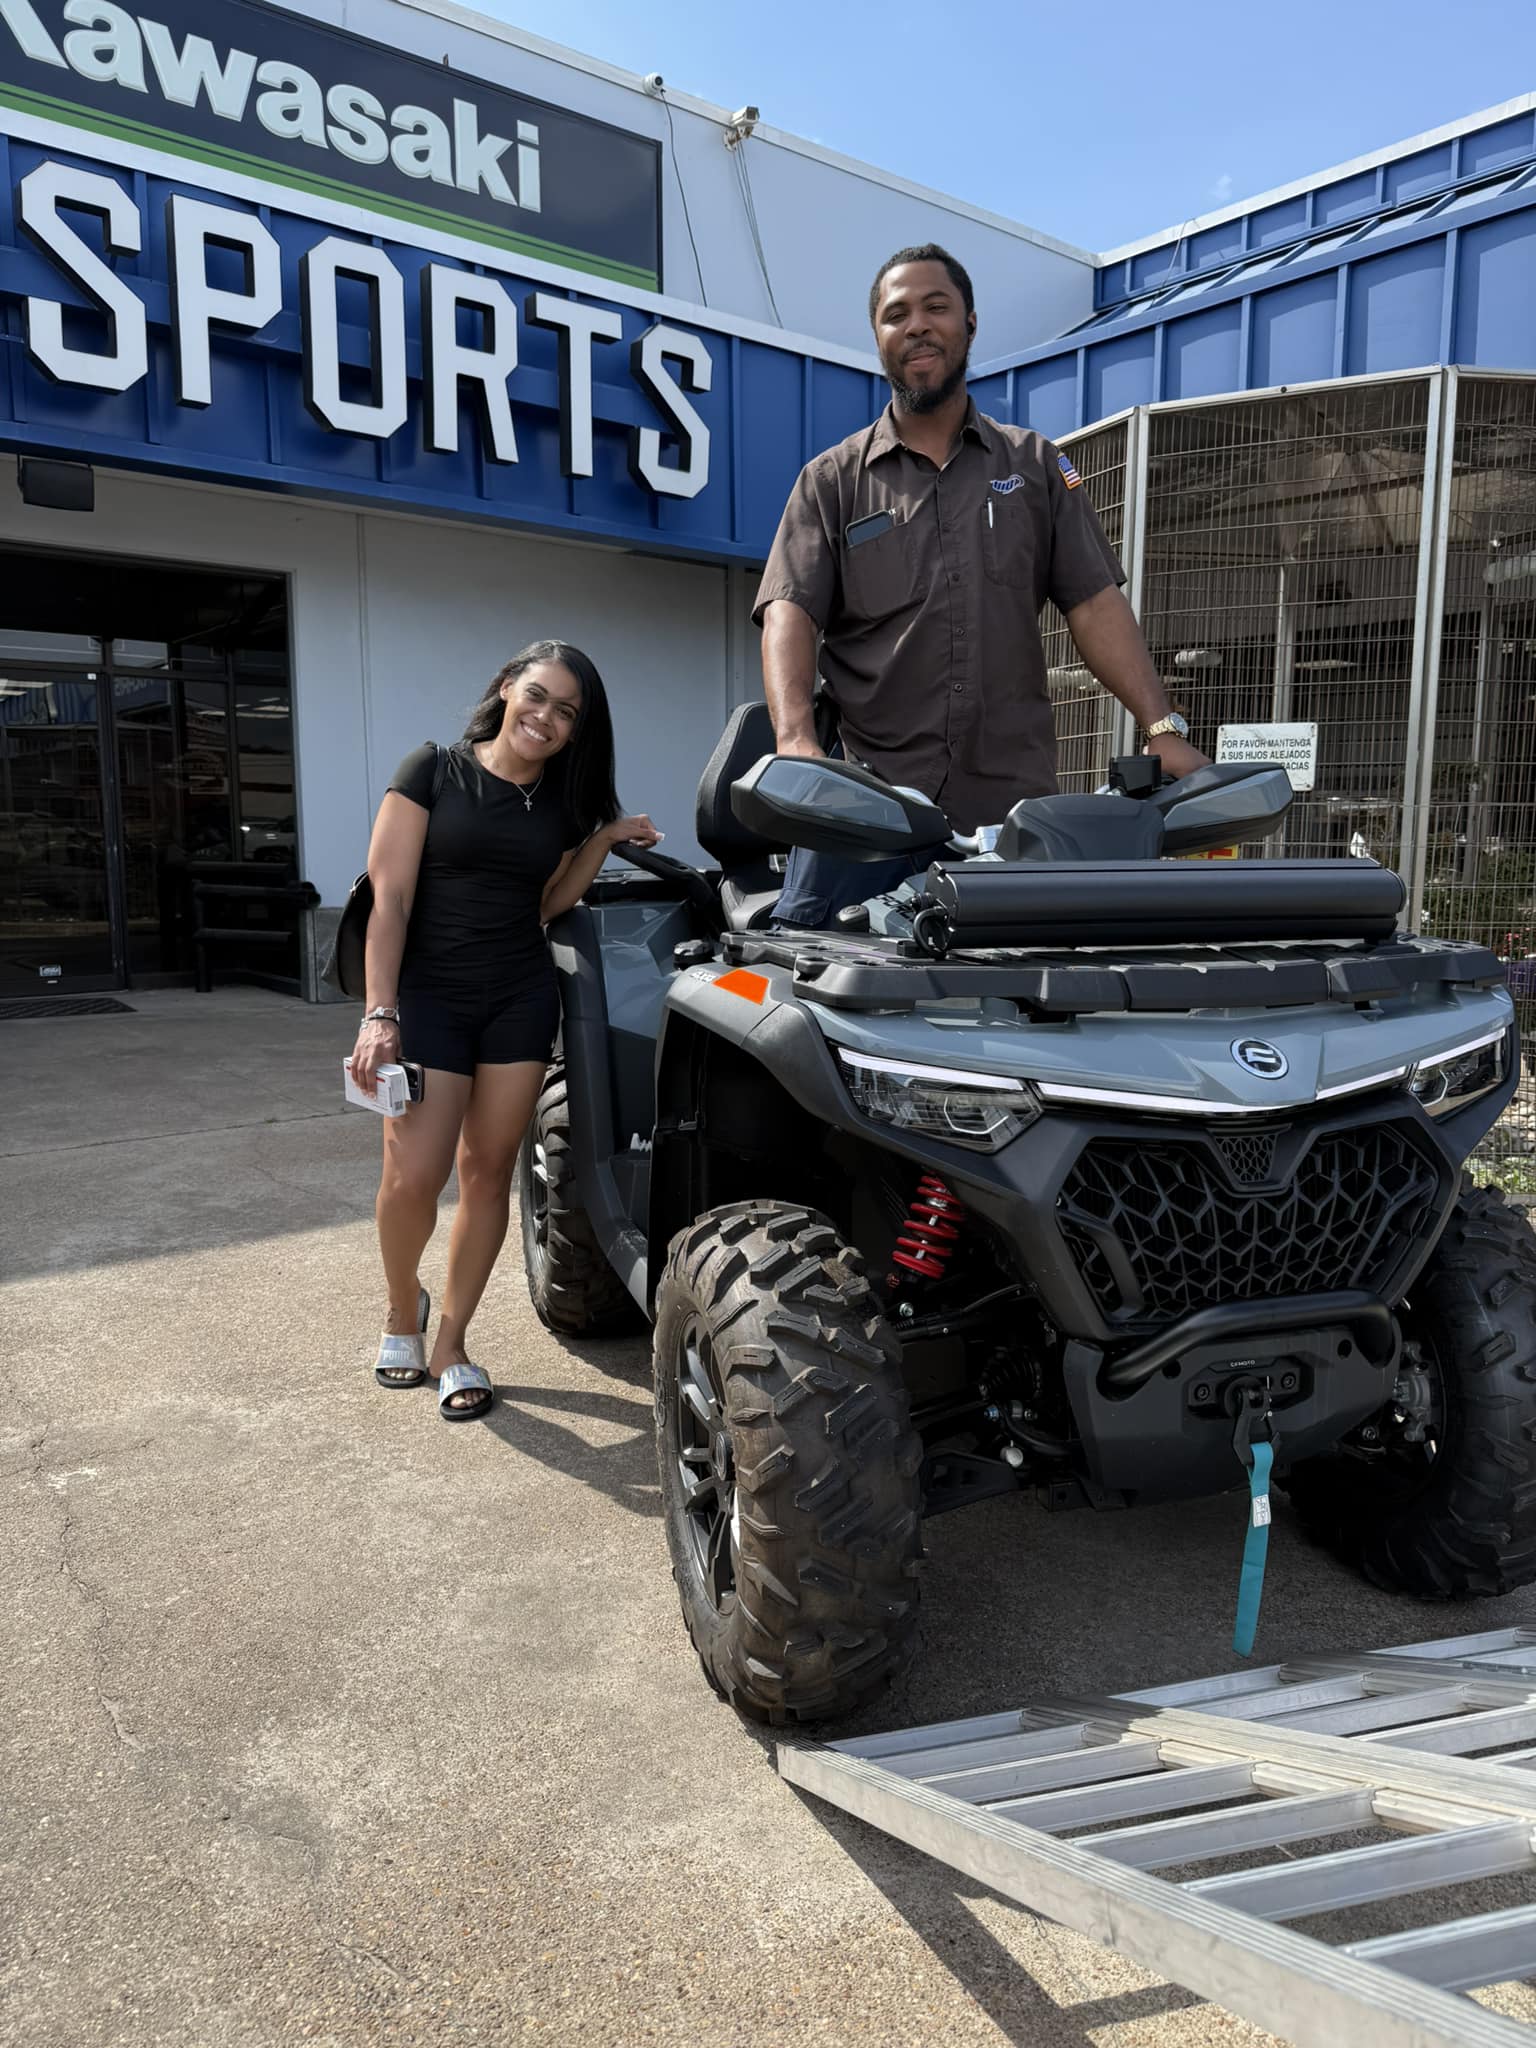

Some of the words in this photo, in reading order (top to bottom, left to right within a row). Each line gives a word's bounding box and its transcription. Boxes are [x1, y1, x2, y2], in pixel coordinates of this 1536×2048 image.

[0, 0, 541, 213] awasaki
[20, 159, 714, 499] SPORTS
[1221, 752, 1226, 760] A
[1228, 751, 1243, 760] SUS
[1245, 751, 1268, 760] HIJOS
[1270, 750, 1311, 759] ALEJADOS
[1222, 740, 1238, 748] POR
[1240, 740, 1266, 748] FAVOR
[1267, 738, 1311, 747] MANTENGA
